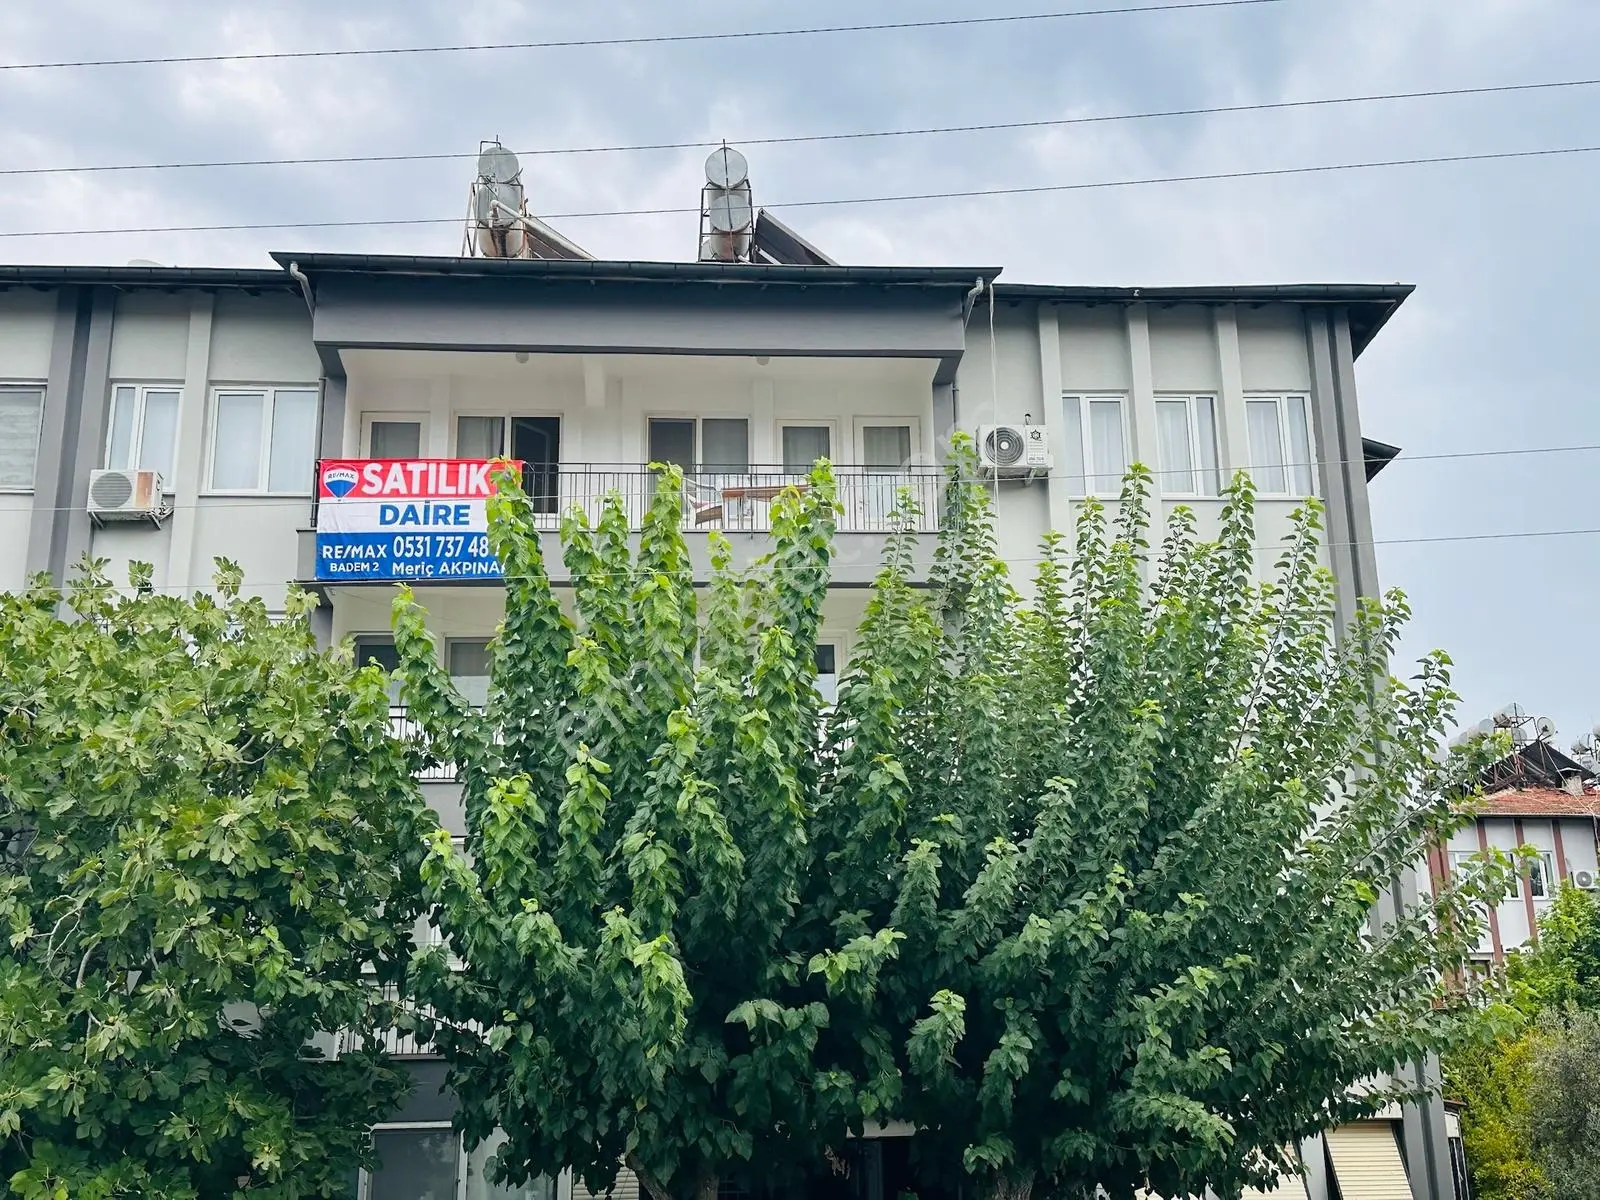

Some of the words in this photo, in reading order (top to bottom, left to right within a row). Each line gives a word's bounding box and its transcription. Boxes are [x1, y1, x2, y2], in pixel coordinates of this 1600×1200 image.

[361, 463, 492, 495] SATILIK
[379, 500, 471, 526] DAİRE
[322, 544, 388, 559] RE/MAX
[393, 536, 430, 558] 0531
[435, 536, 465, 558] 737
[468, 536, 489, 558] 48
[329, 563, 370, 572] BADEM
[372, 563, 380, 571] 2
[392, 562, 434, 577] Meriç
